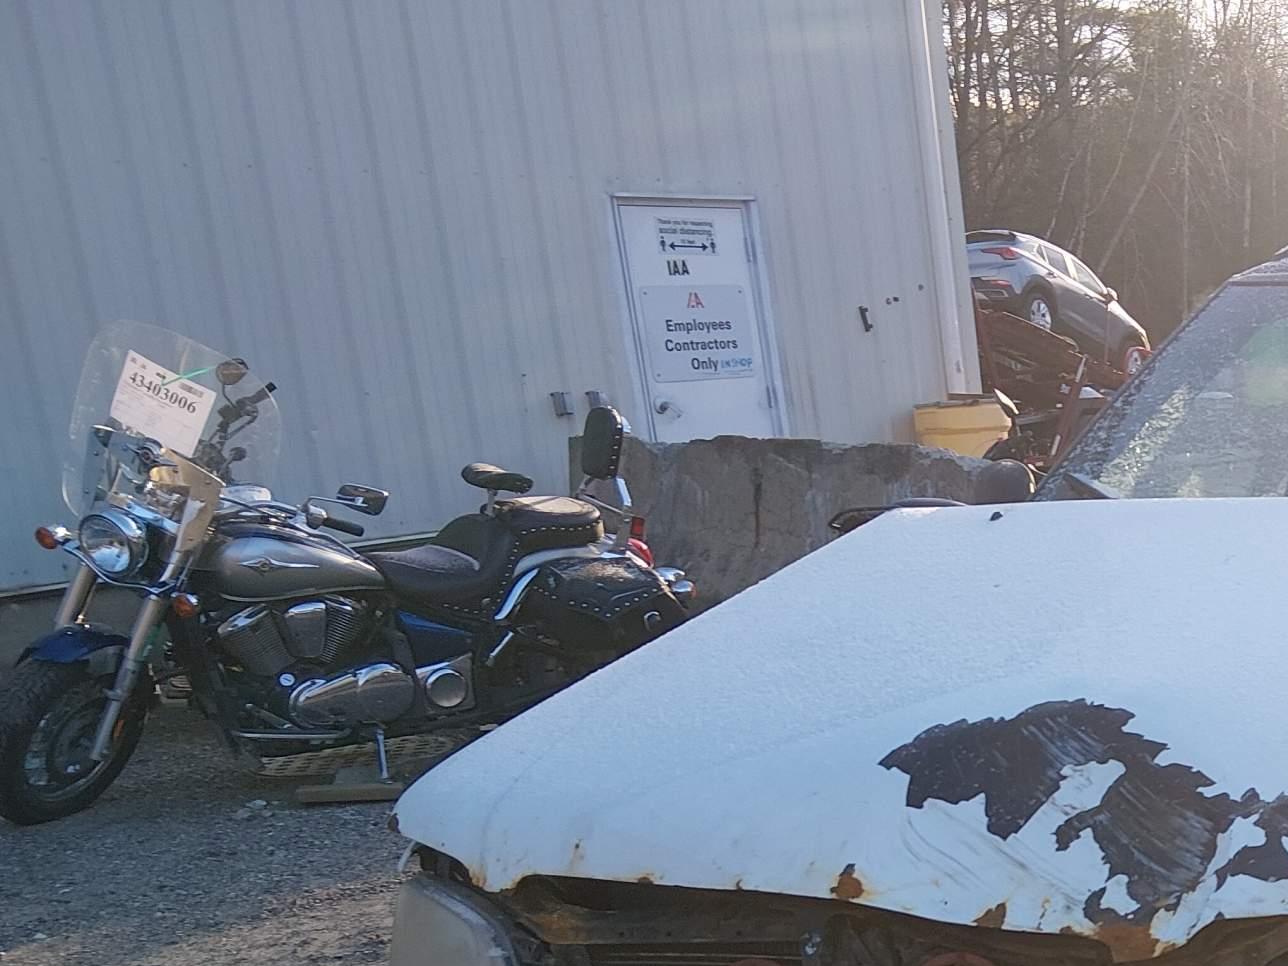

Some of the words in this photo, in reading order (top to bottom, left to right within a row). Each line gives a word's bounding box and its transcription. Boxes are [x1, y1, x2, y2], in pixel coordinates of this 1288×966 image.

[666, 260, 690, 276] IAA
[665, 318, 732, 334] Employees
[665, 339, 739, 352] Contractors
[691, 357, 719, 371] Only
[129, 372, 200, 414] 43403006
